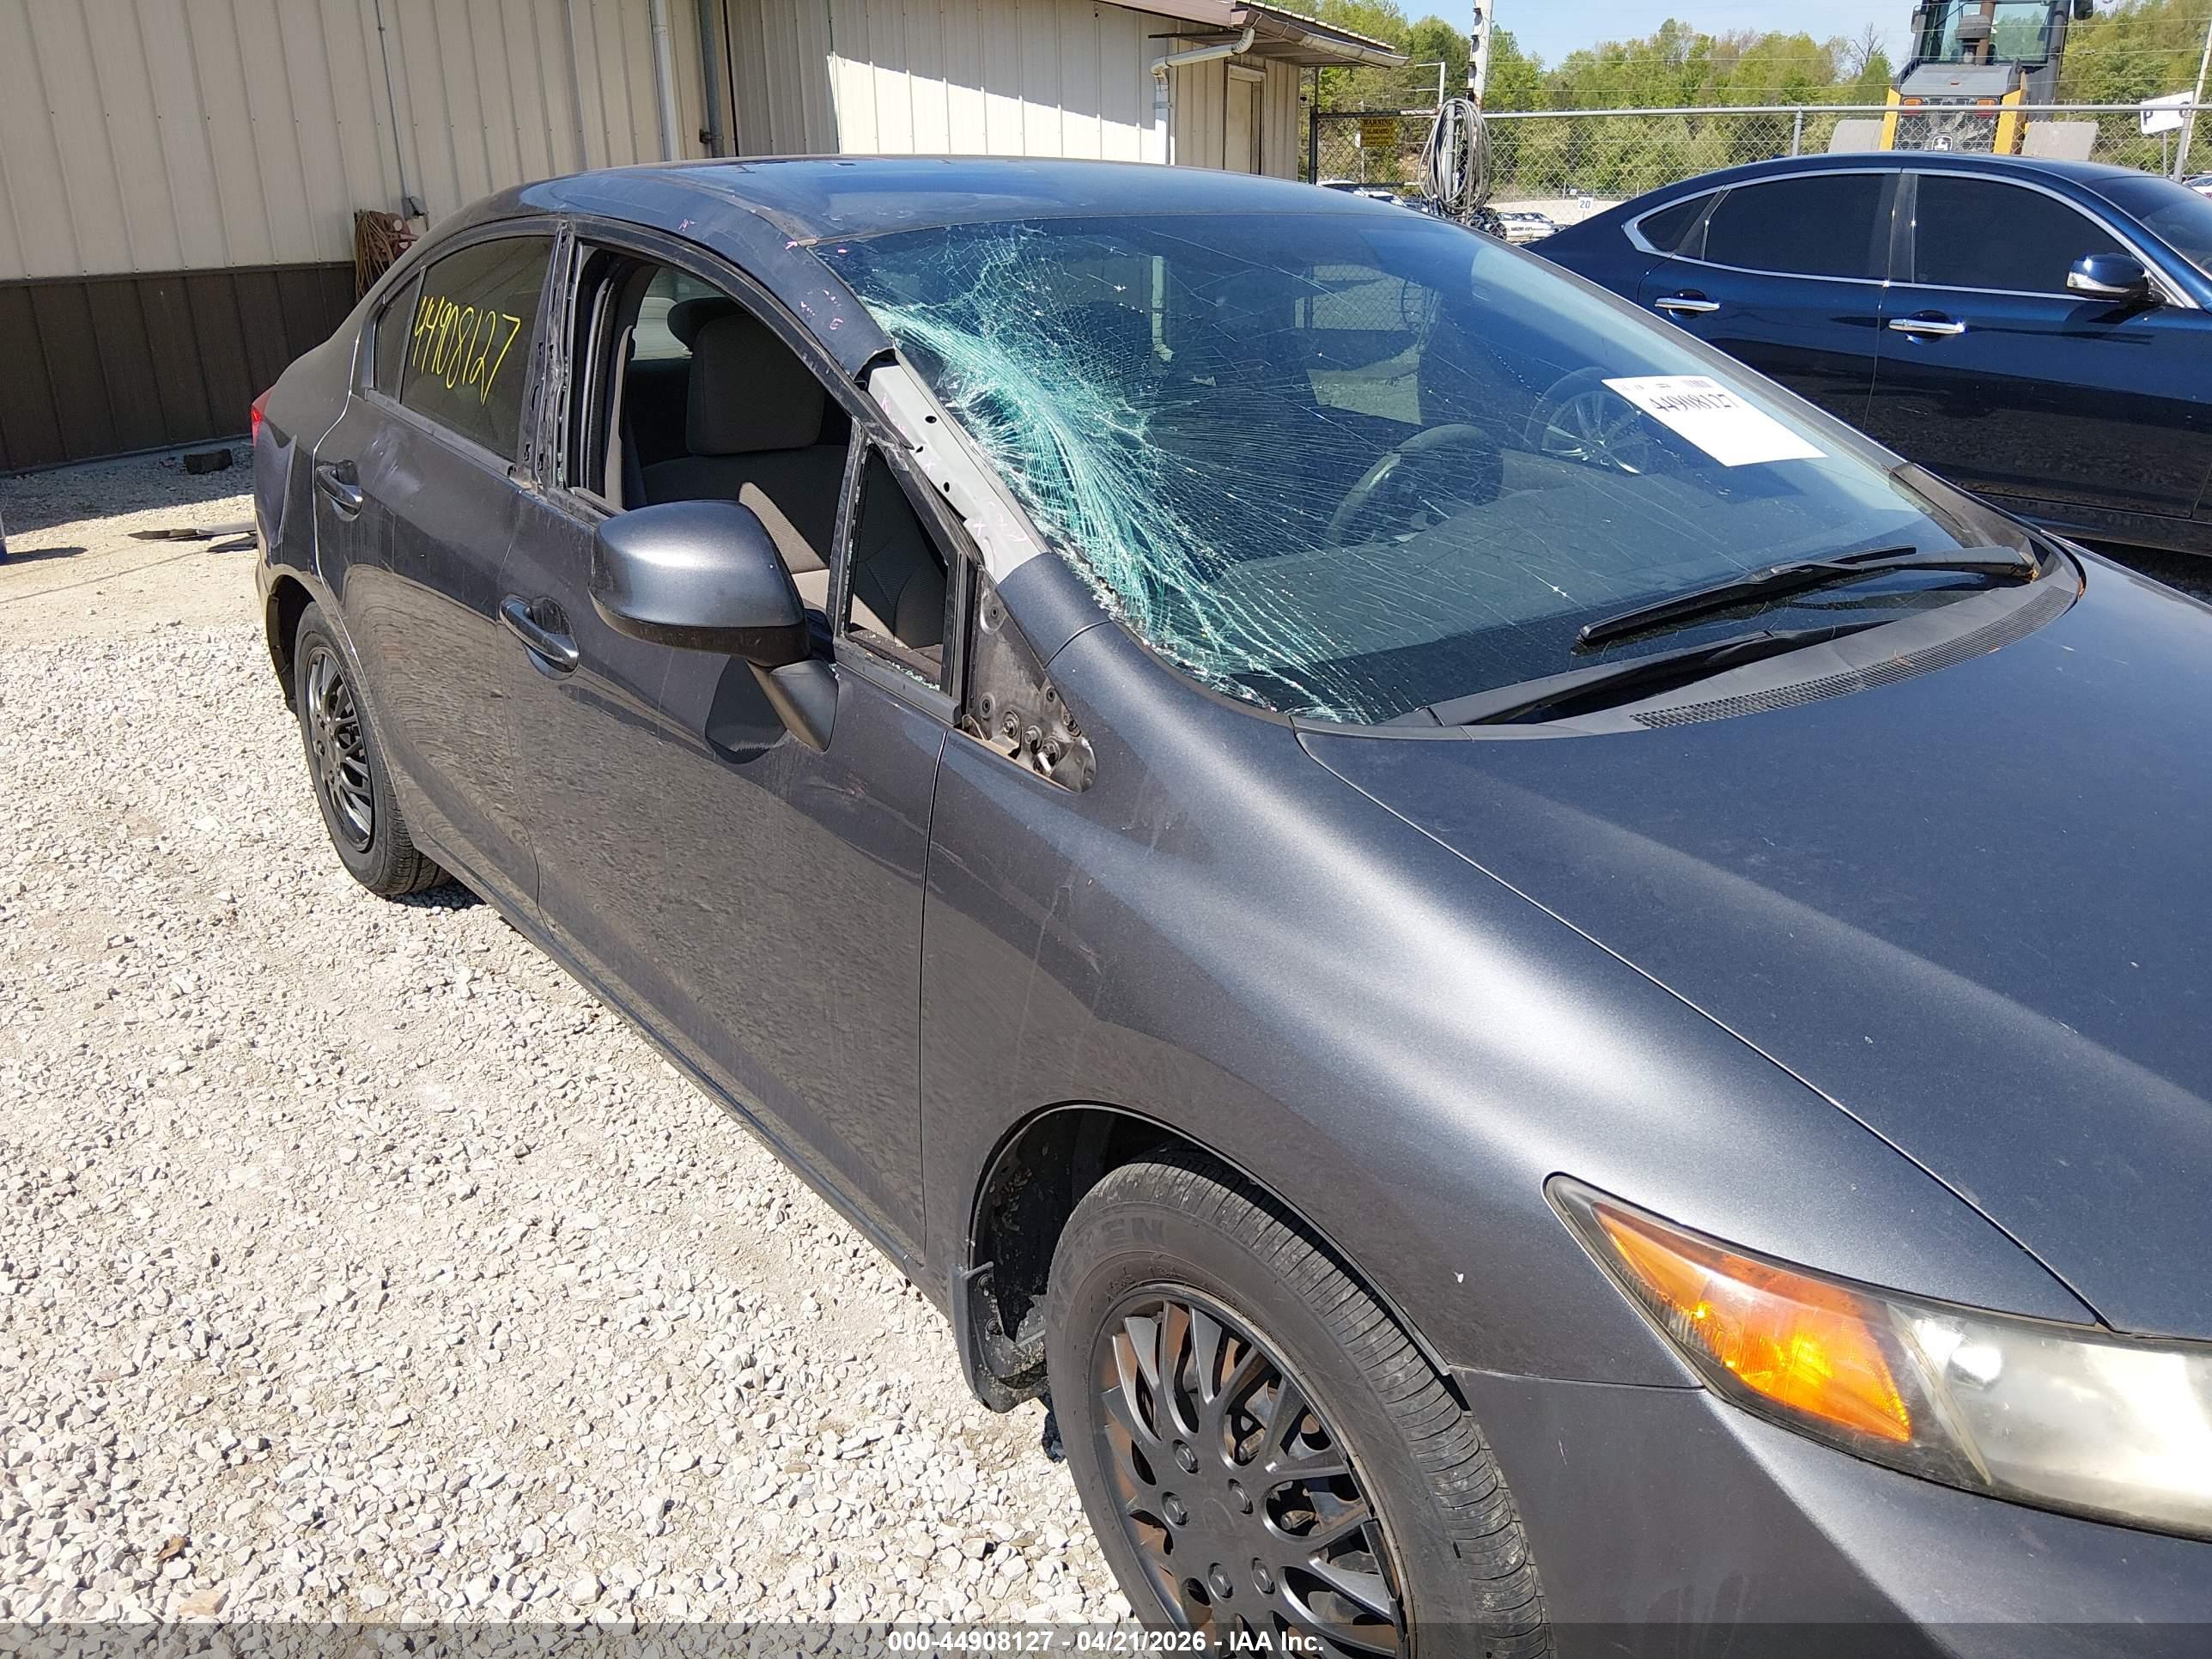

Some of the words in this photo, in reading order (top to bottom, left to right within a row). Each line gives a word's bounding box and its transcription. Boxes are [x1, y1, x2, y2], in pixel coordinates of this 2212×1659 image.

[1579, 200, 1591, 210] 20
[412, 295, 521, 406] 44908127
[1649, 393, 1739, 413] 44908127
